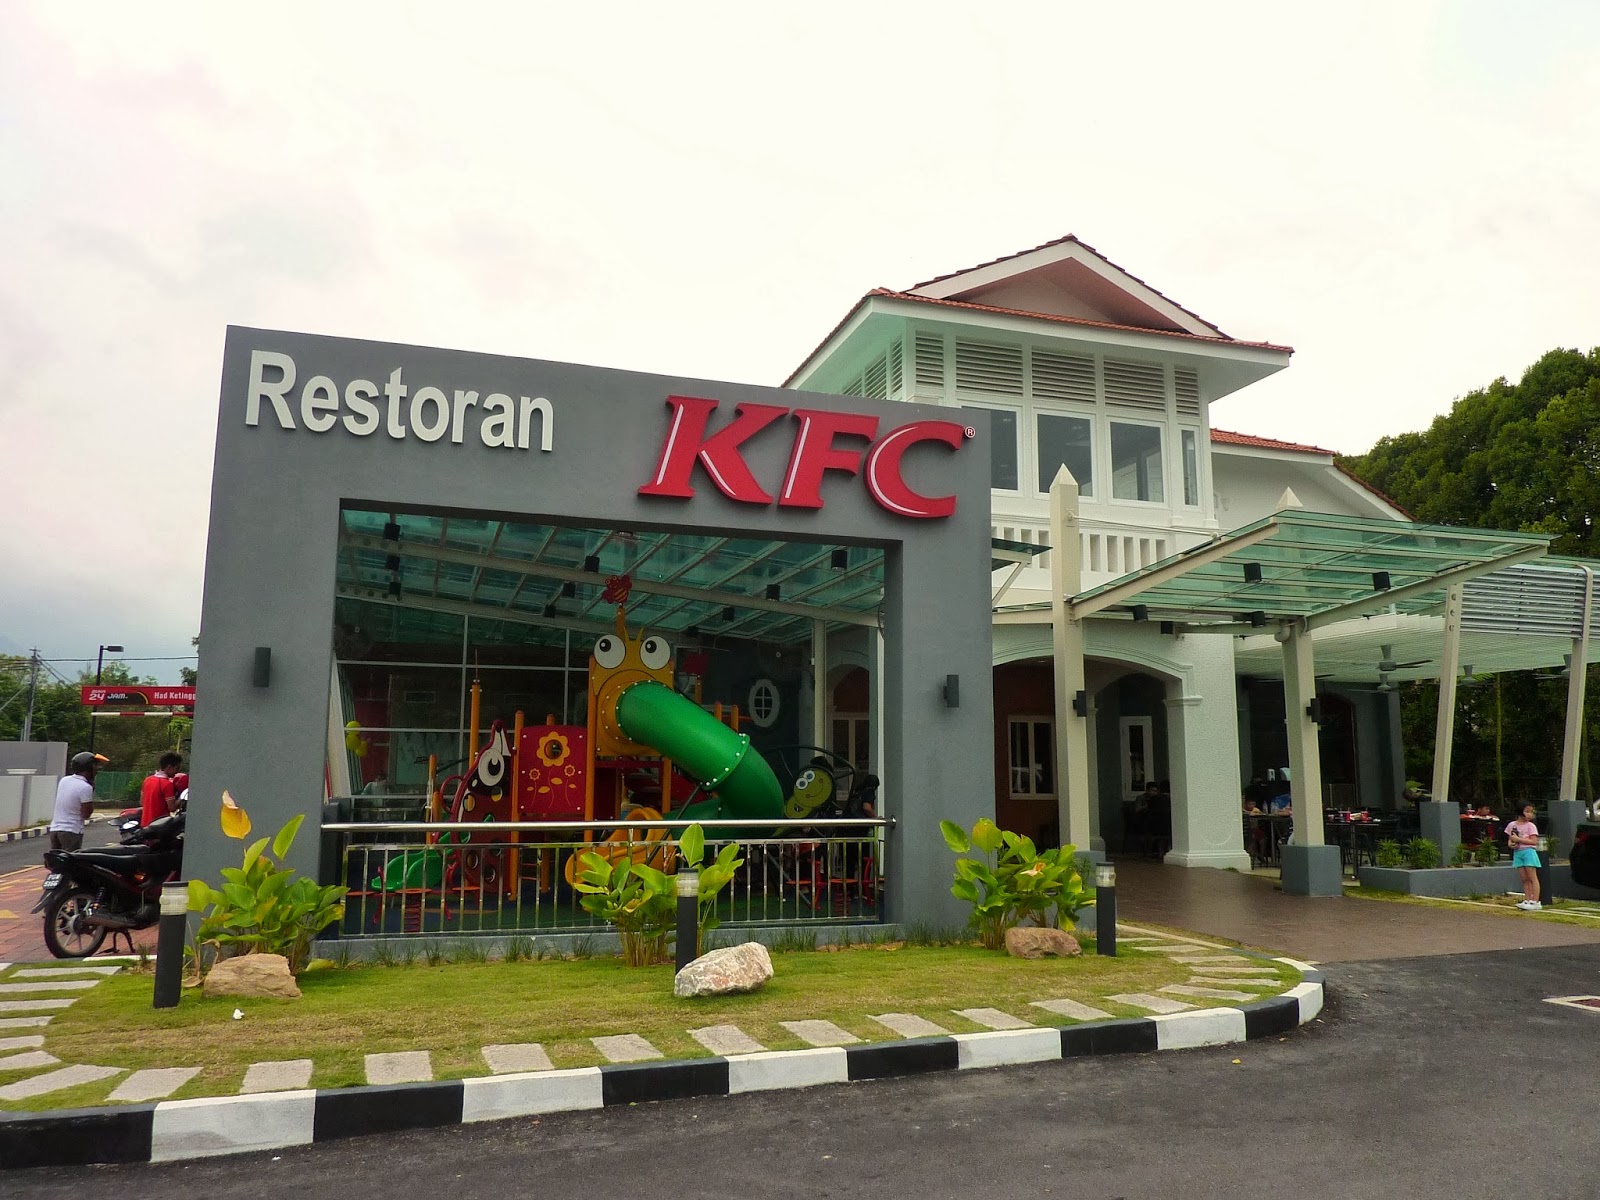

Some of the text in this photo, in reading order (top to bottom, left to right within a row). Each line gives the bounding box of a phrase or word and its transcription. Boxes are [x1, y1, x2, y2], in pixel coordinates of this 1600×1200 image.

[245, 350, 554, 451] Restoran
[637, 395, 965, 518] KFC
[89, 693, 105, 701] 24
